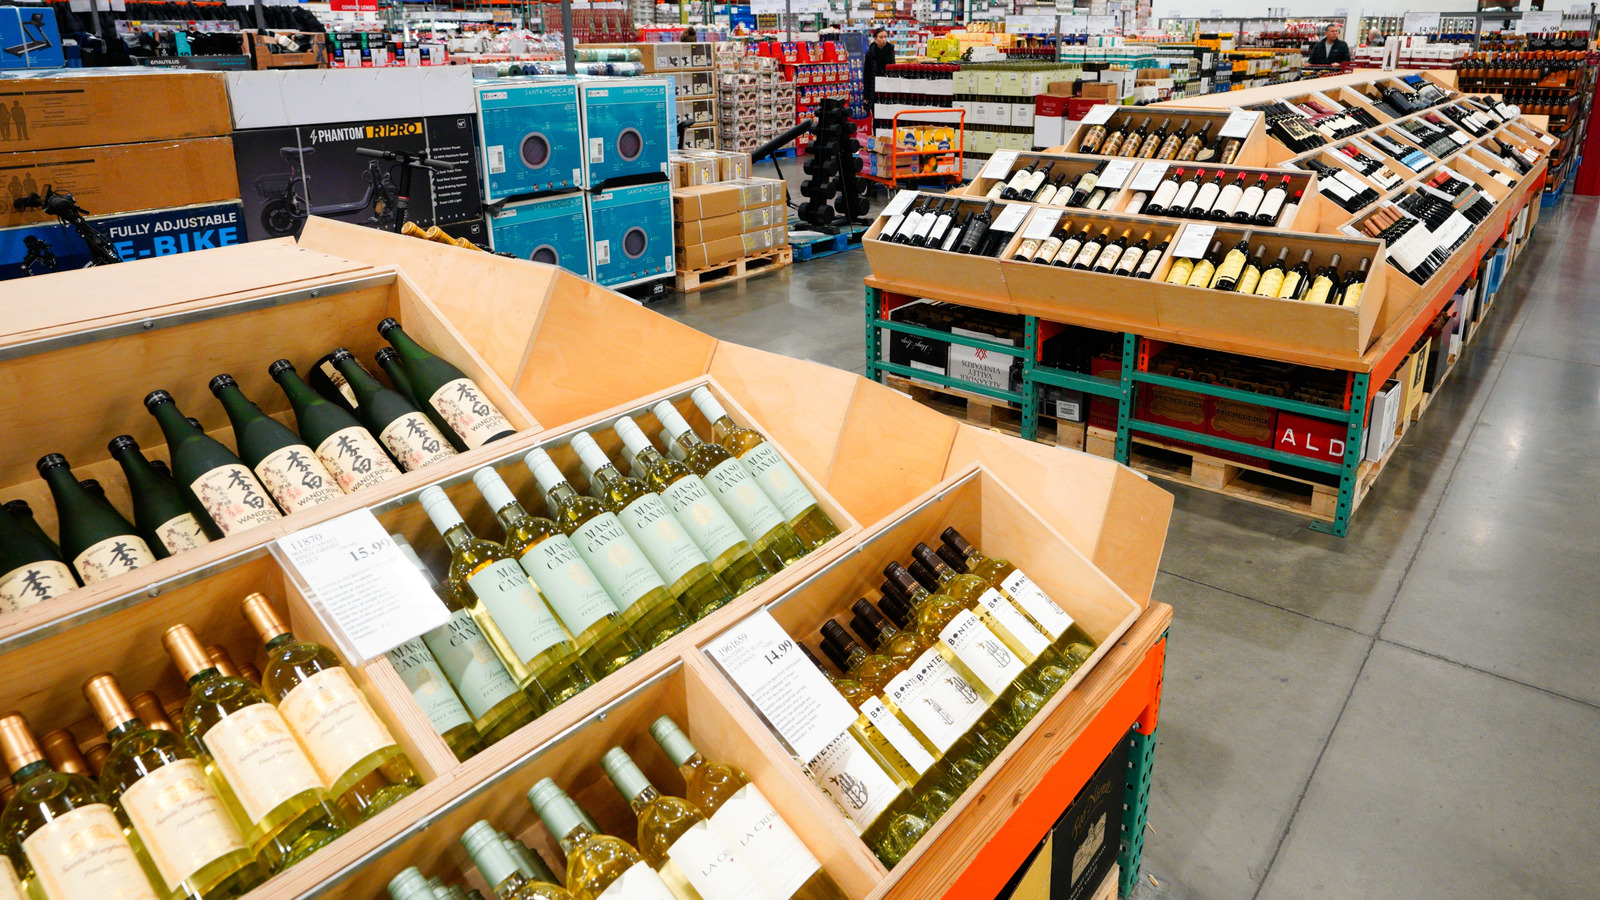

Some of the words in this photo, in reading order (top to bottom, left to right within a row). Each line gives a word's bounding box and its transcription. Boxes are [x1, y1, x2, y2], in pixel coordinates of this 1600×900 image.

[318, 127, 365, 143] PHANTOM
[109, 223, 150, 238] FULLY
[154, 212, 237, 233] ADJUSTABLE
[113, 226, 239, 263] E-BIKE
[961, 359, 1001, 375] VINEYARDS
[968, 369, 992, 380] VALLEY
[960, 374, 1002, 389] ALEXANDER
[1154, 393, 1202, 409] CONUNDRUM
[485, 420, 502, 429] POET
[1216, 408, 1268, 425] CONUNDRUM
[748, 448, 772, 466] MASO
[1210, 447, 1264, 463] CONUNDRUM
[714, 464, 739, 482] MASO
[750, 454, 781, 478] CANALI
[351, 467, 393, 492] WANDERING
[365, 476, 384, 488] POET
[718, 470, 749, 494] CANALI
[314, 494, 336, 504] POET
[670, 481, 698, 500] MASO
[634, 499, 661, 516] MASO
[673, 487, 707, 513] CANALI
[257, 515, 278, 524] POET
[584, 519, 614, 539] MASO
[290, 533, 323, 551] 11870
[587, 526, 625, 553] CANALI
[108, 541, 139, 572] 李
[349, 538, 391, 562] 15.99
[19, 569, 52, 601] 李
[391, 641, 425, 659] MASO
[718, 632, 748, 657] 1961659
[764, 639, 793, 665] 14.99
[740, 833, 754, 846] LA
[702, 864, 717, 876] LA
